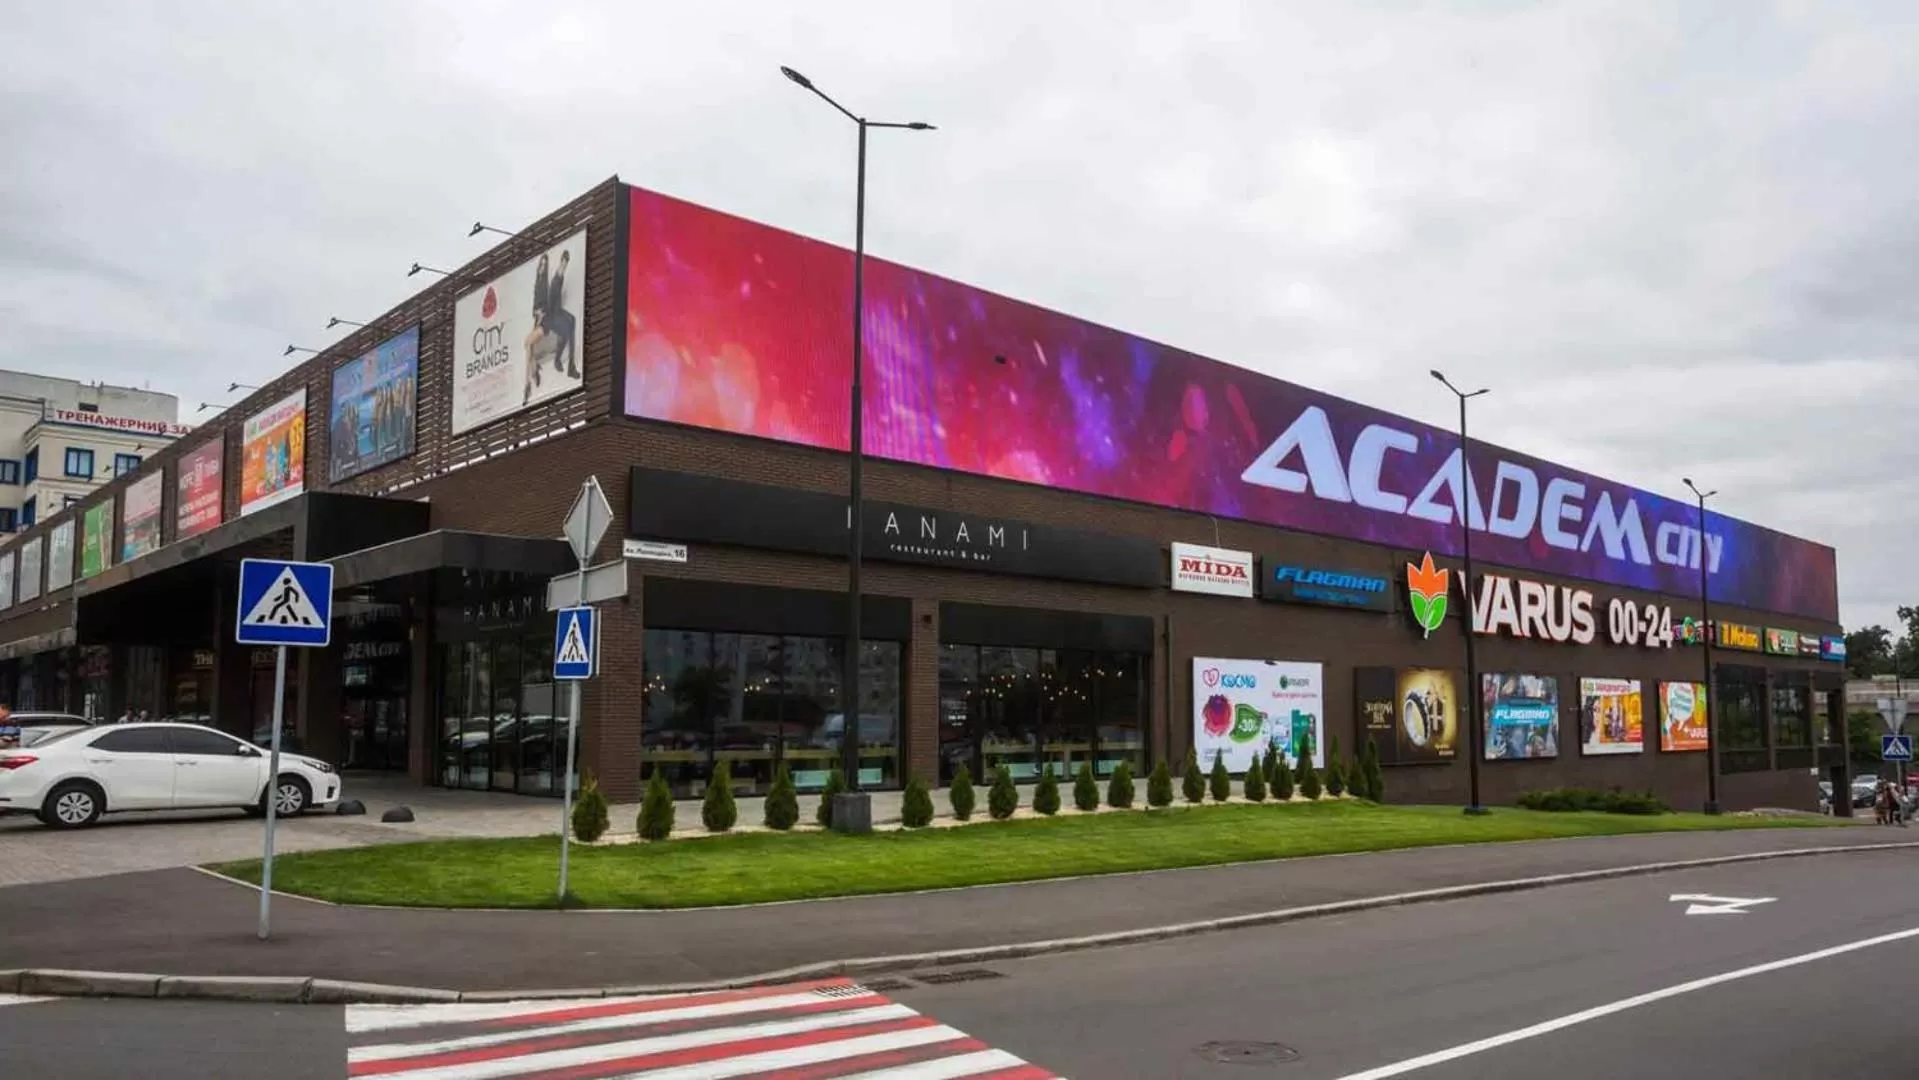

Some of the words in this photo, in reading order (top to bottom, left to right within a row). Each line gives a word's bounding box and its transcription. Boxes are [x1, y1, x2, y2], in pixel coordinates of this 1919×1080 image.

[472, 322, 505, 355] CITY
[465, 346, 510, 379] BRANDS
[56, 409, 168, 434] ТРЕНАЖЕРНИЙ
[1240, 405, 1652, 566] ACADEM
[1655, 521, 1724, 574] CITY
[1180, 558, 1248, 579] MIDA
[1276, 565, 1387, 593] FLAGMAN
[1458, 570, 1596, 644] VARUS
[1609, 598, 1673, 648] 00-24
